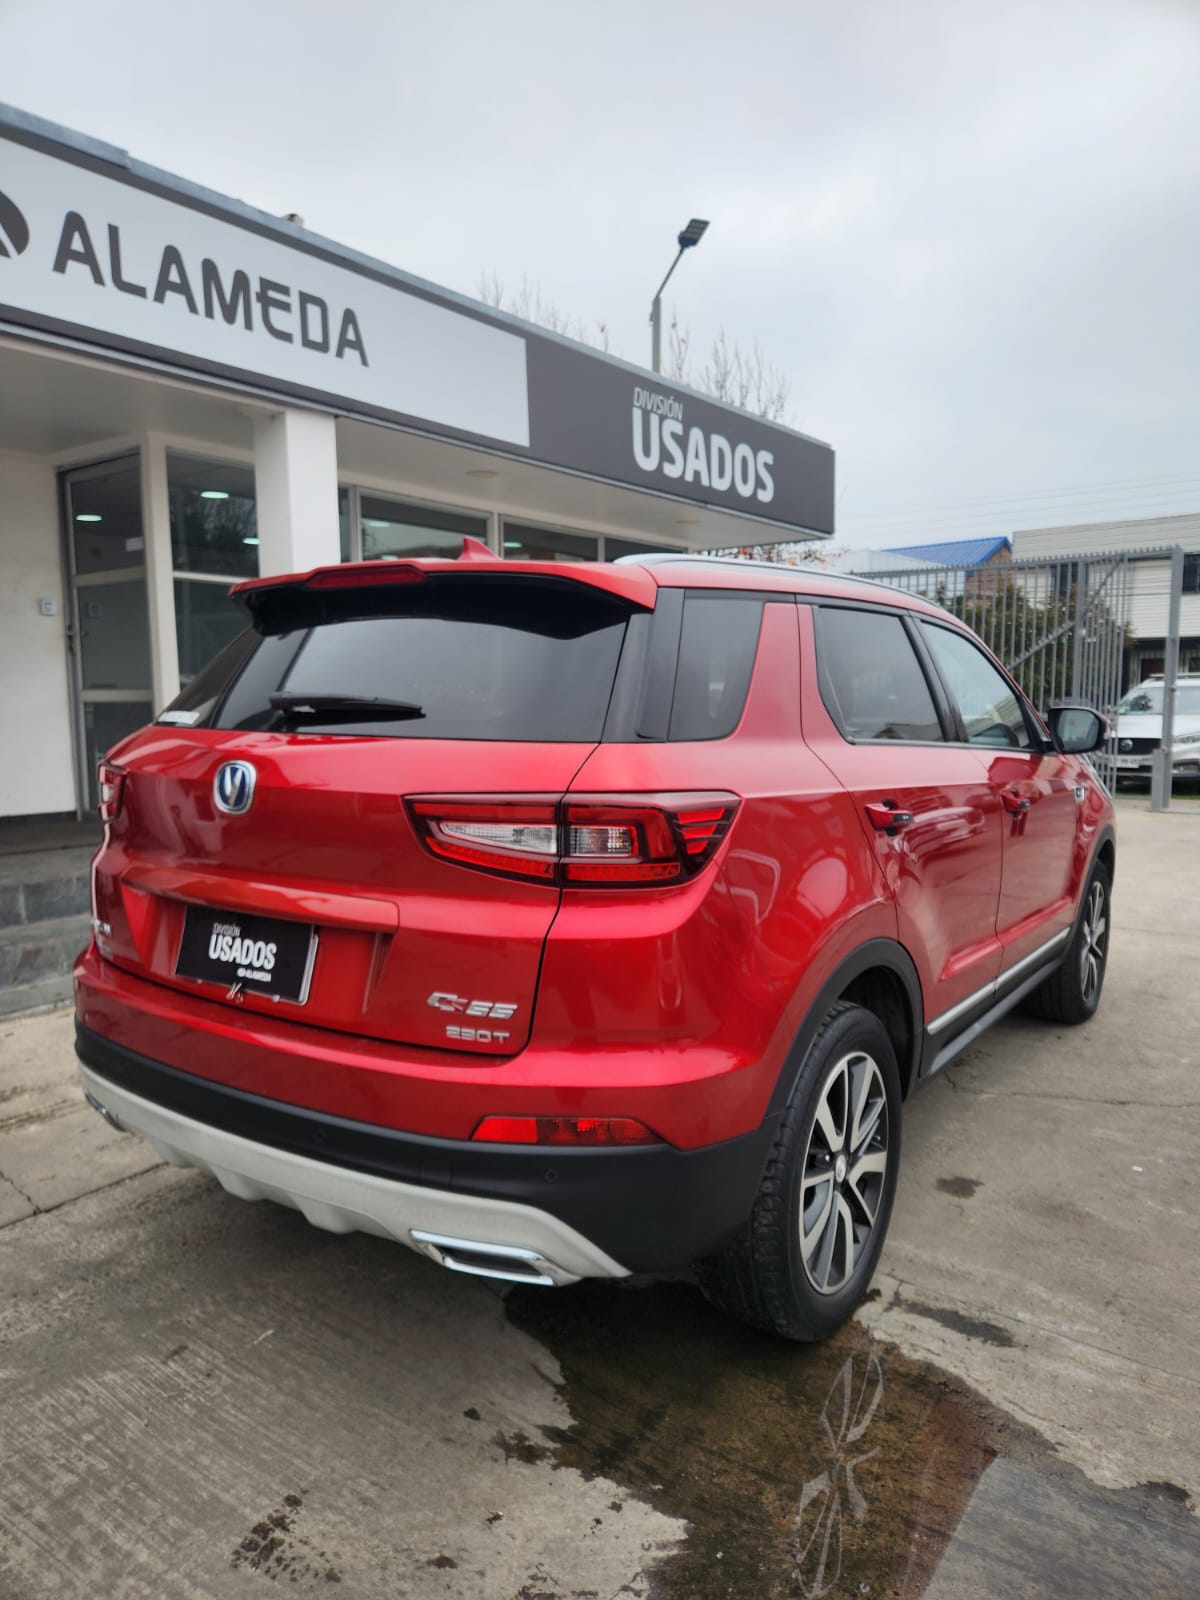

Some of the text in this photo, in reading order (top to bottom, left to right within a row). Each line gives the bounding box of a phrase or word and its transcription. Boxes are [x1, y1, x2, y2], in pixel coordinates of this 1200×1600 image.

[53, 210, 370, 368] ALAMEDA
[633, 386, 684, 421] DIVISIÓN
[632, 406, 775, 504] USADOS
[208, 934, 277, 970] USADOS
